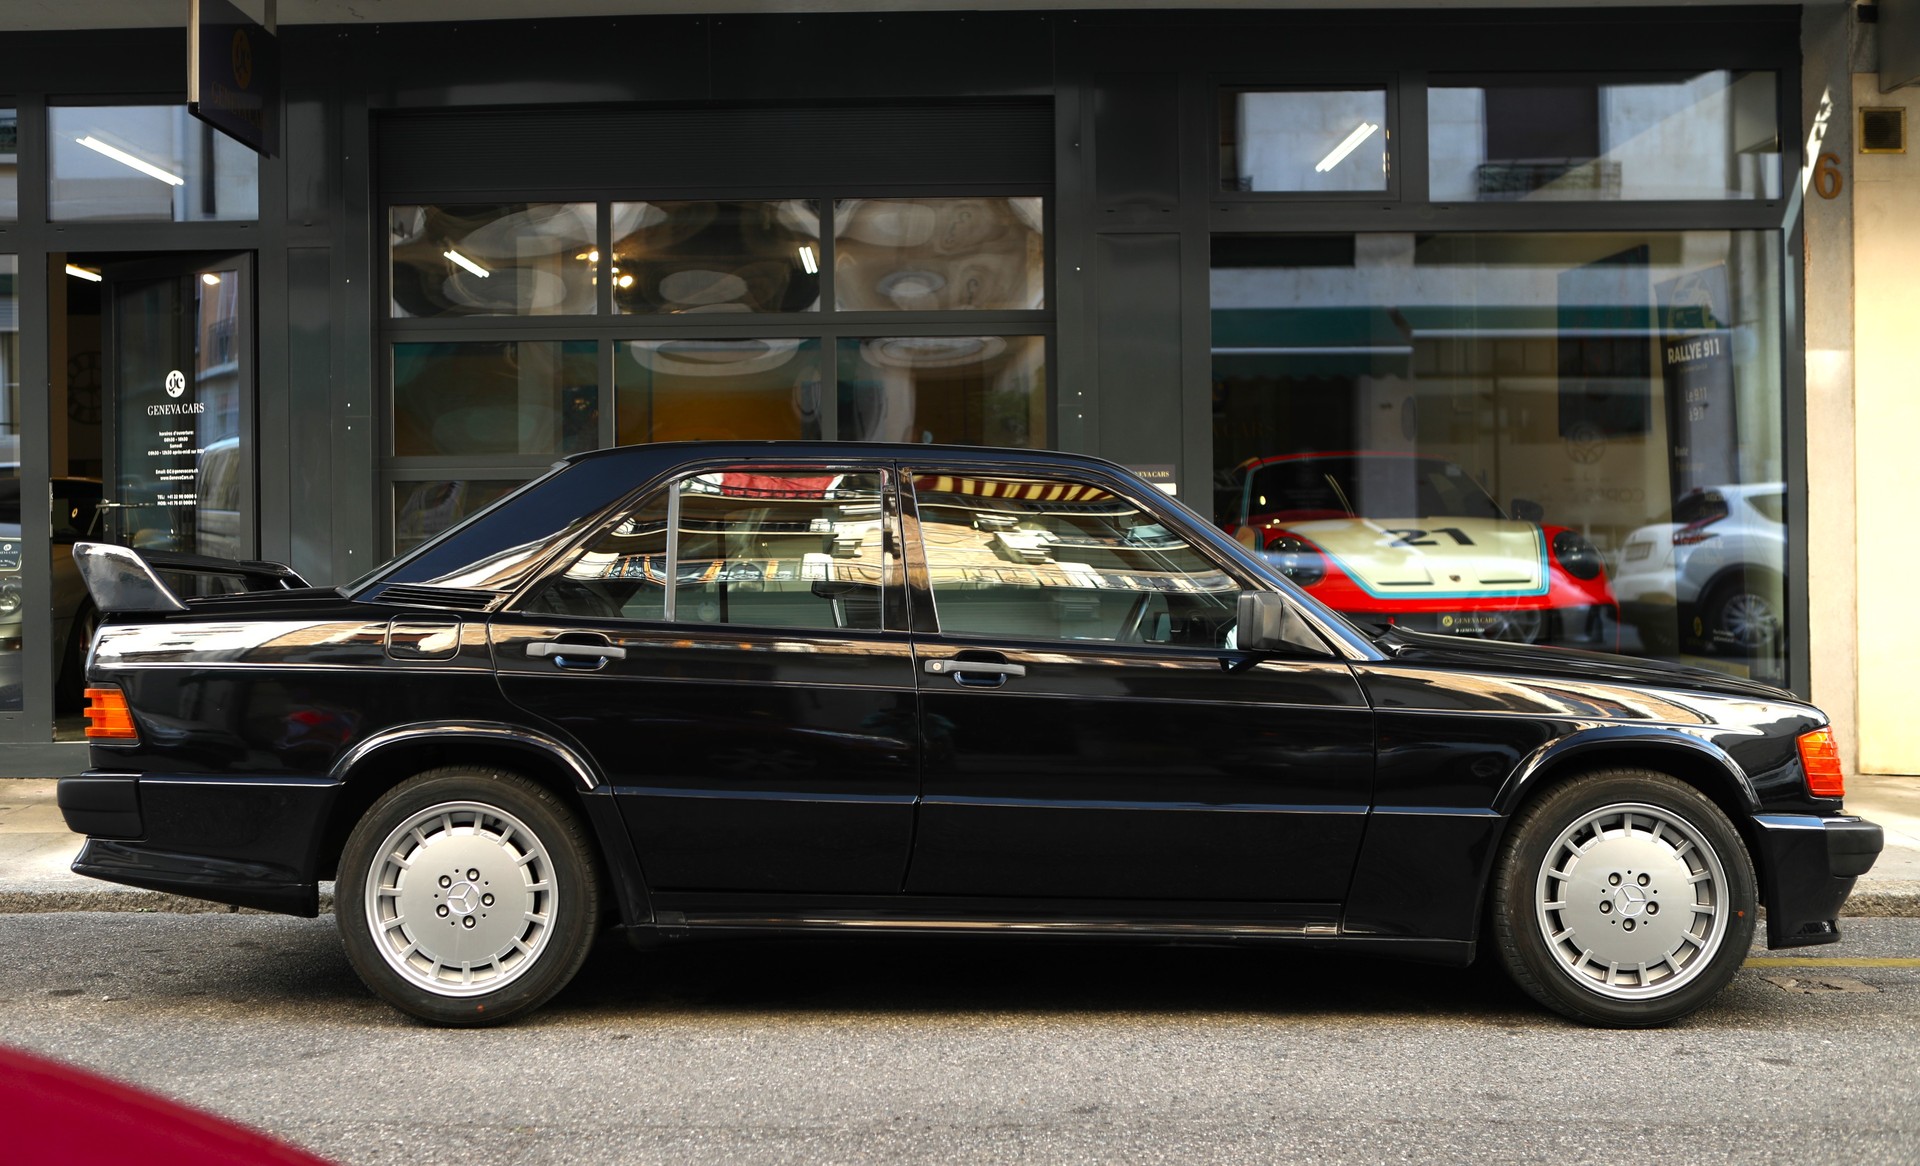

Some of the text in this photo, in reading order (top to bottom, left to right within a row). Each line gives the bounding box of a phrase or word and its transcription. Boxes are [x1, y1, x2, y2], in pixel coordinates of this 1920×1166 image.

[1815, 152, 1843, 200] 6
[1667, 338, 1720, 364] RALLYE 911
[147, 402, 205, 416] GENEVA CARS
[1382, 527, 1476, 548] 21
